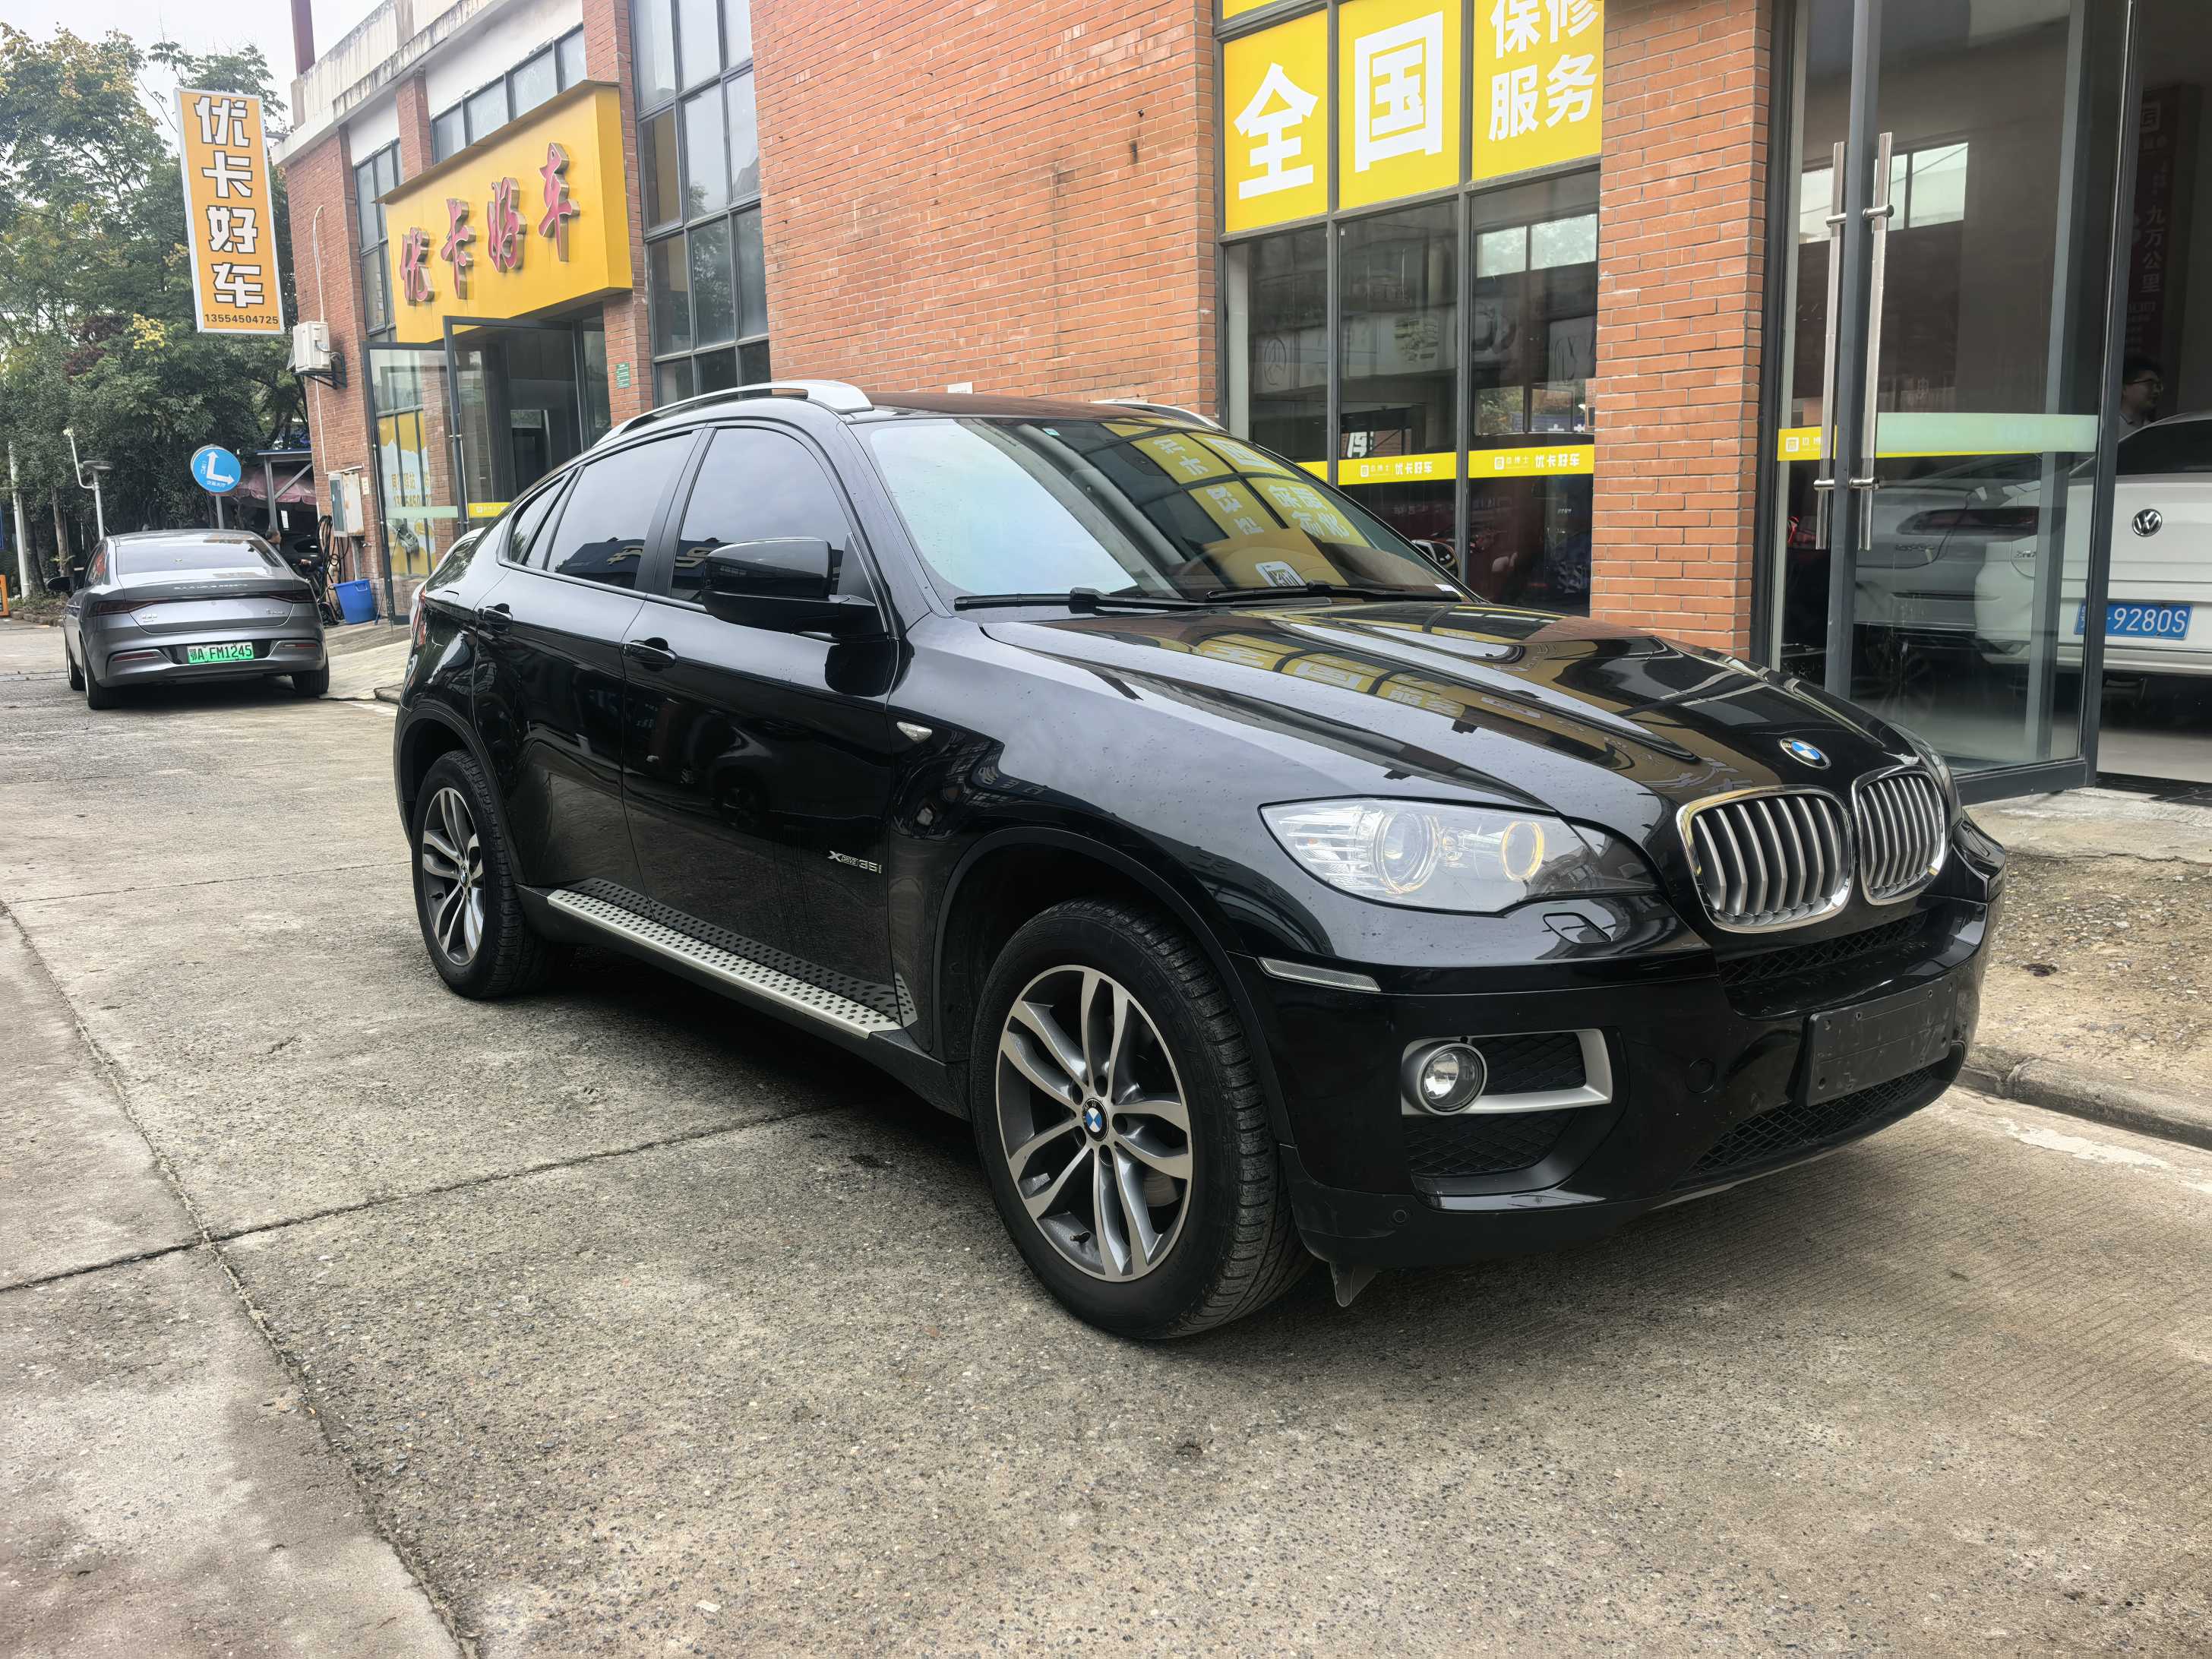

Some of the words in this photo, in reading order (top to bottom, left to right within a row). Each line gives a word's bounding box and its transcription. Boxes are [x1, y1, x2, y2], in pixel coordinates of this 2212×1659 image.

[1490, 0, 1599, 59] 保修
[1232, 10, 1443, 201] 全国
[1488, 54, 1597, 142] 服务
[194, 96, 264, 308] 优卡好车
[400, 141, 580, 306] 优卡好车
[2140, 205, 2166, 293] 九万公里
[204, 313, 279, 324] 13554504725
[1395, 461, 1433, 475] 优卡好车
[1534, 453, 1581, 469] 优卡好车
[210, 644, 252, 659] FM1245
